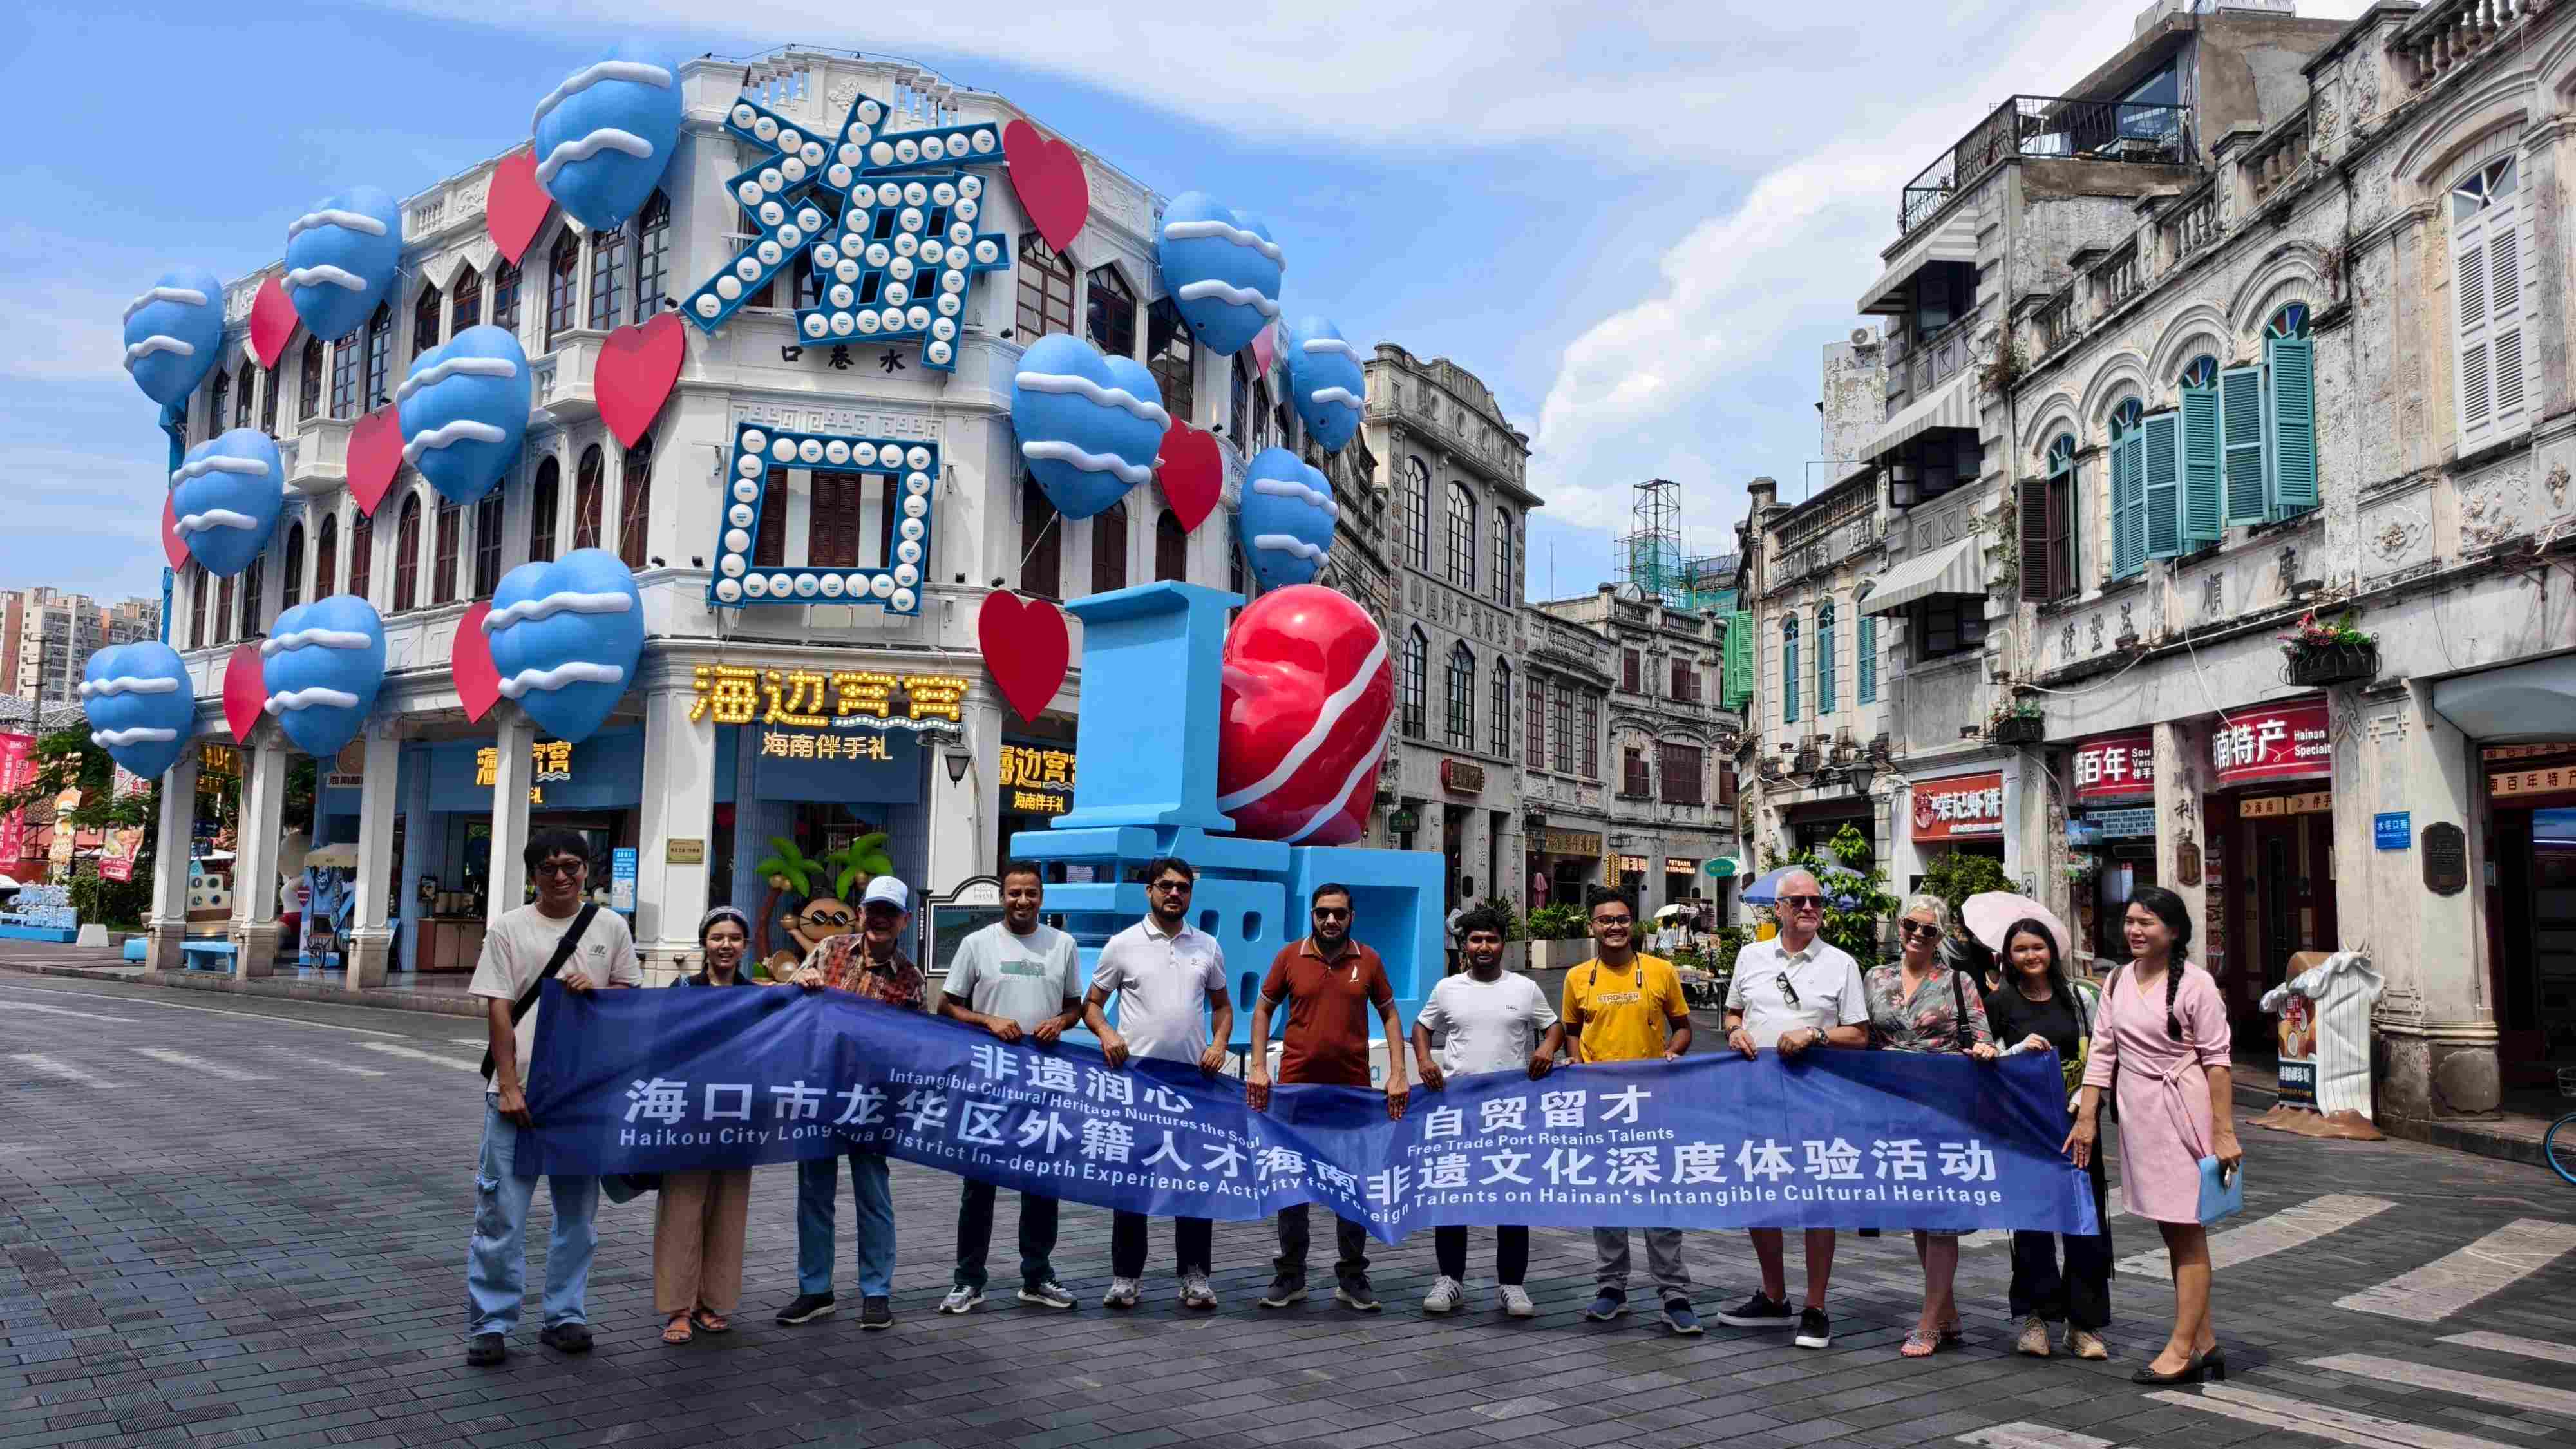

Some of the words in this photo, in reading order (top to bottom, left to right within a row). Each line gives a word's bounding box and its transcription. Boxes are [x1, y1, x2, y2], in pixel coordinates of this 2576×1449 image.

[761, 732, 893, 760] 海南伴手礼
[2294, 730, 2325, 741] Hainan
[2132, 768, 2154, 780] 伴手
[1014, 791, 1065, 813] 海南伴手礼
[971, 1043, 1194, 1113] 非遗润心
[1423, 1084, 1651, 1141] 自贸留才
[890, 1068, 975, 1093] Intangible
[980, 1081, 1046, 1106] Cultural
[1050, 1093, 1120, 1118] Heritage
[1125, 1107, 1197, 1130] Nurtures
[1200, 1122, 1225, 1137] the
[1229, 1130, 1260, 1149] Soul
[623, 1077, 1997, 1206] 海口市龙华区外籍人才海南非遗文化深度体验活动
[1408, 1142, 1442, 1157] Free
[1446, 1137, 1493, 1152] Trade
[1499, 1133, 1533, 1146] Port
[1539, 1132, 1604, 1146] Retains
[1608, 1128, 1674, 1142] Talents
[620, 1128, 711, 1146] Haikou
[719, 1127, 770, 1145] City
[779, 1122, 875, 1142] Longua
[882, 1126, 965, 1160] District
[972, 1147, 1076, 1178] In-depth
[1083, 1167, 1209, 1192] Experience
[1217, 1177, 1300, 1200] Activity
[1307, 1177, 1335, 1195] for
[1415, 1188, 1497, 1208] Talents
[1504, 1190, 1532, 1203] on
[1540, 1187, 1643, 1205] Hainan's
[1650, 1185, 1776, 1208] Intangible
[1784, 1184, 1886, 1202] Cultural
[1893, 1184, 2002, 1206] Heritage
